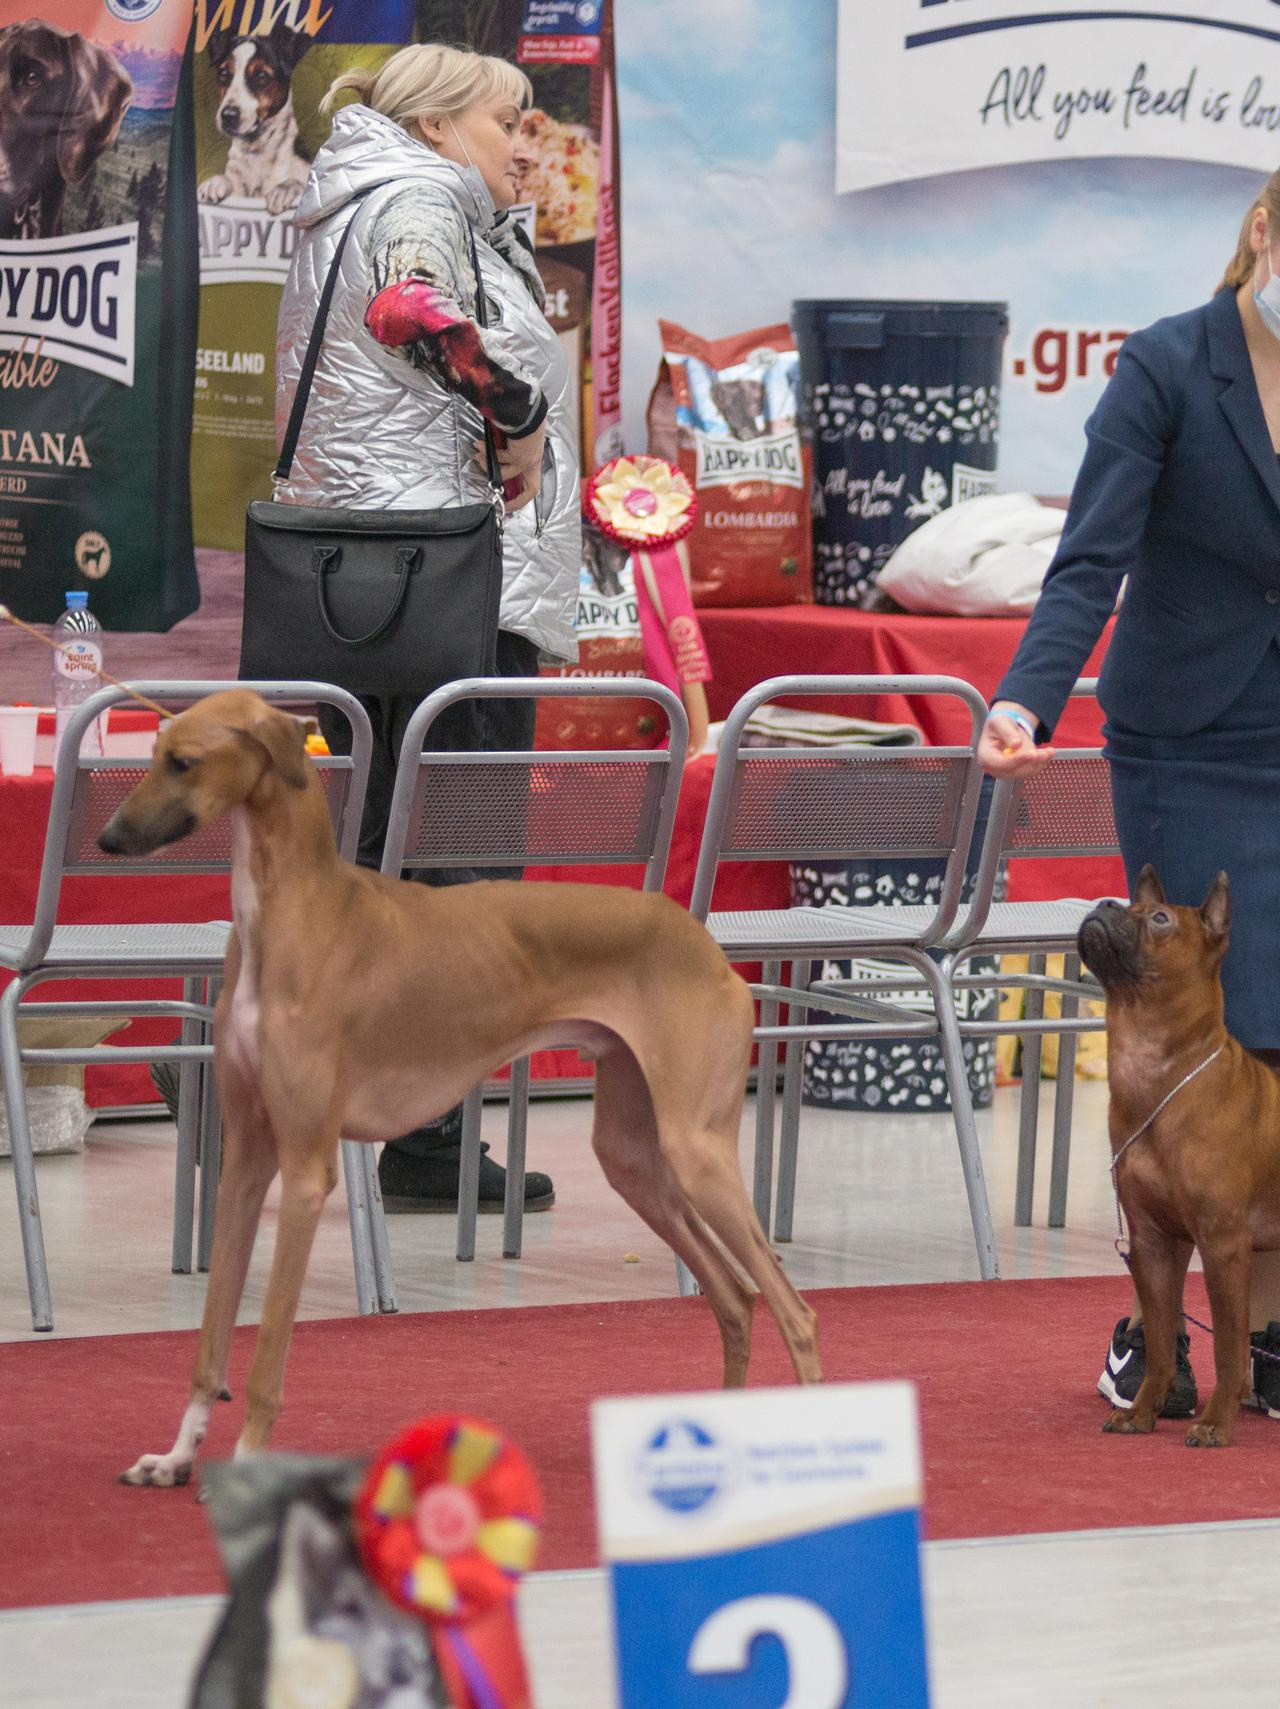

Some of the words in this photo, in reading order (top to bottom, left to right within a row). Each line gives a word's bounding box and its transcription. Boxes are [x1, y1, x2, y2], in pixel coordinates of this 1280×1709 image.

[980, 64, 1047, 125] All
[1053, 89, 1115, 139] you
[1124, 61, 1197, 127] feed
[1200, 86, 1230, 119] is
[31, 259, 121, 341] DOG
[577, 601, 619, 624] APPY
